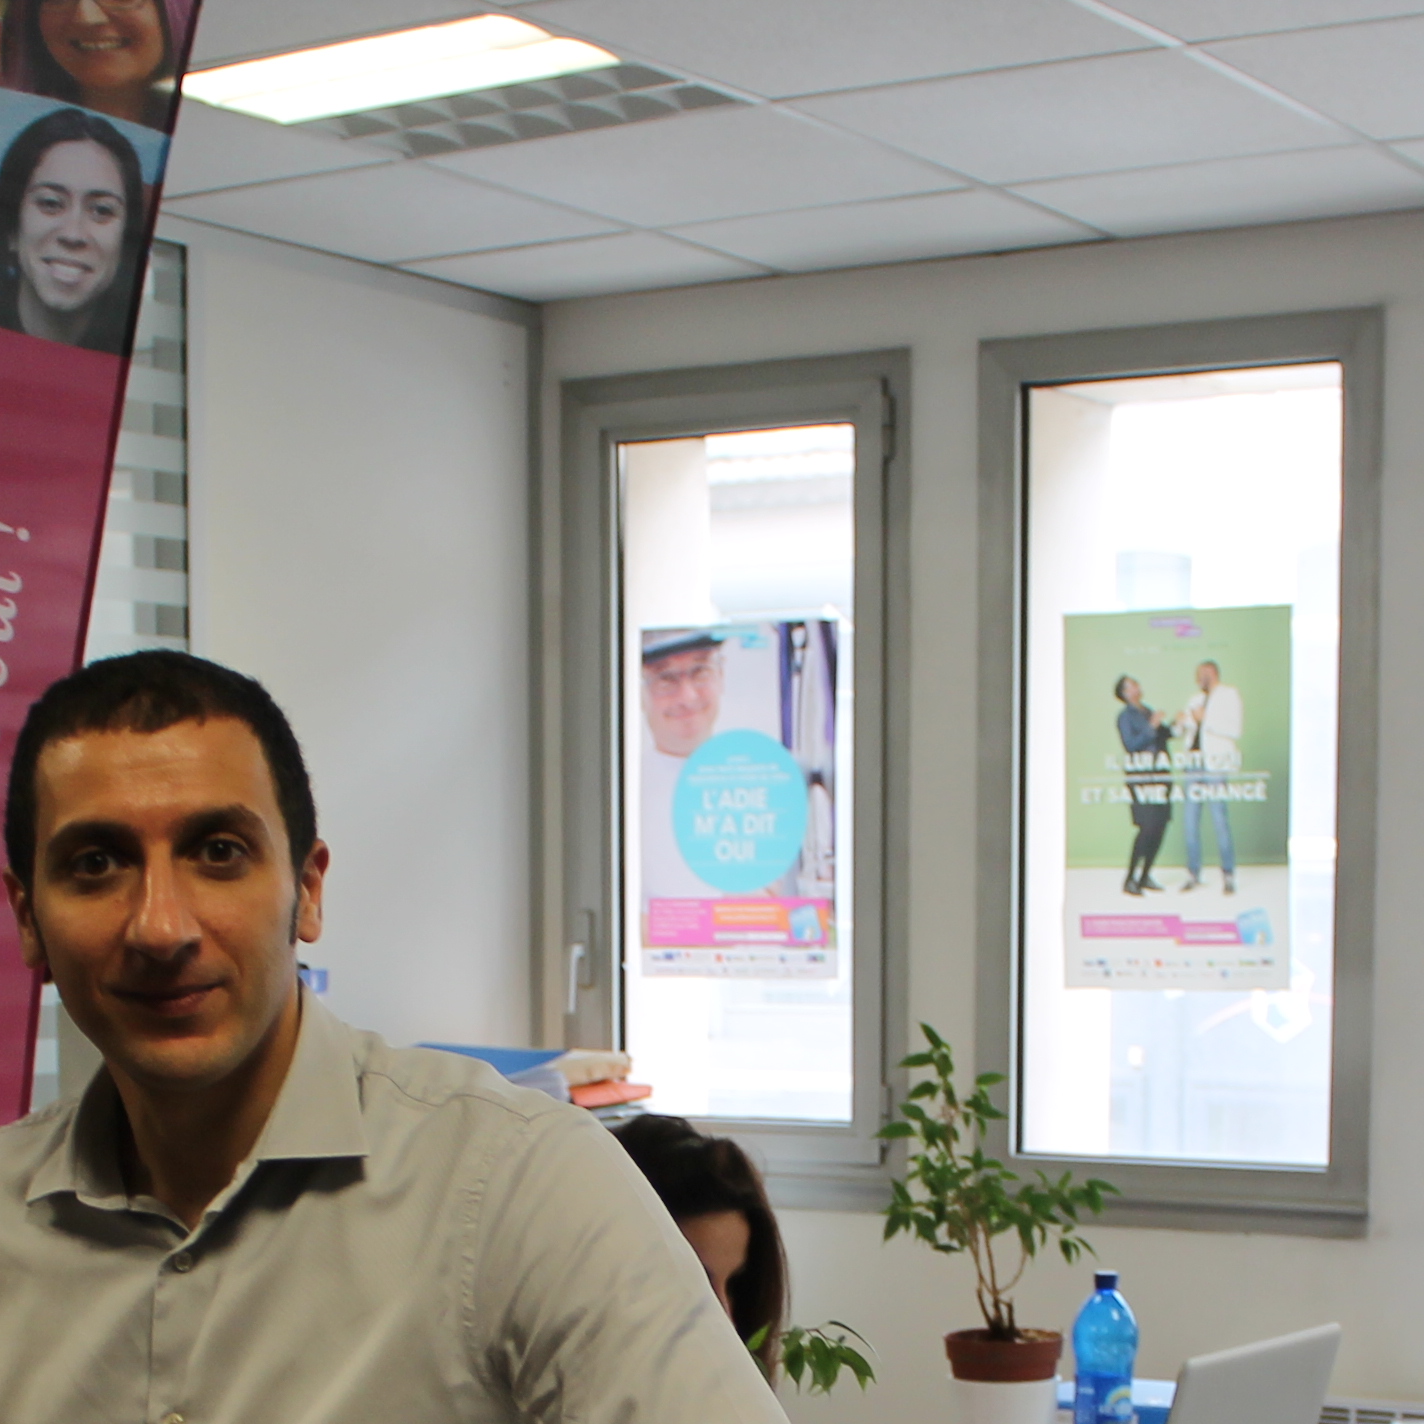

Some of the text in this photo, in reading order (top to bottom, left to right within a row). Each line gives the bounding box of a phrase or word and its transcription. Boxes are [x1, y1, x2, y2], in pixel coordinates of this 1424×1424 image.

[702, 786, 769, 811] L'ADIE
[1134, 784, 1168, 804] VIE
[694, 812, 777, 837] M'A DIT
[714, 839, 757, 863] OUI
